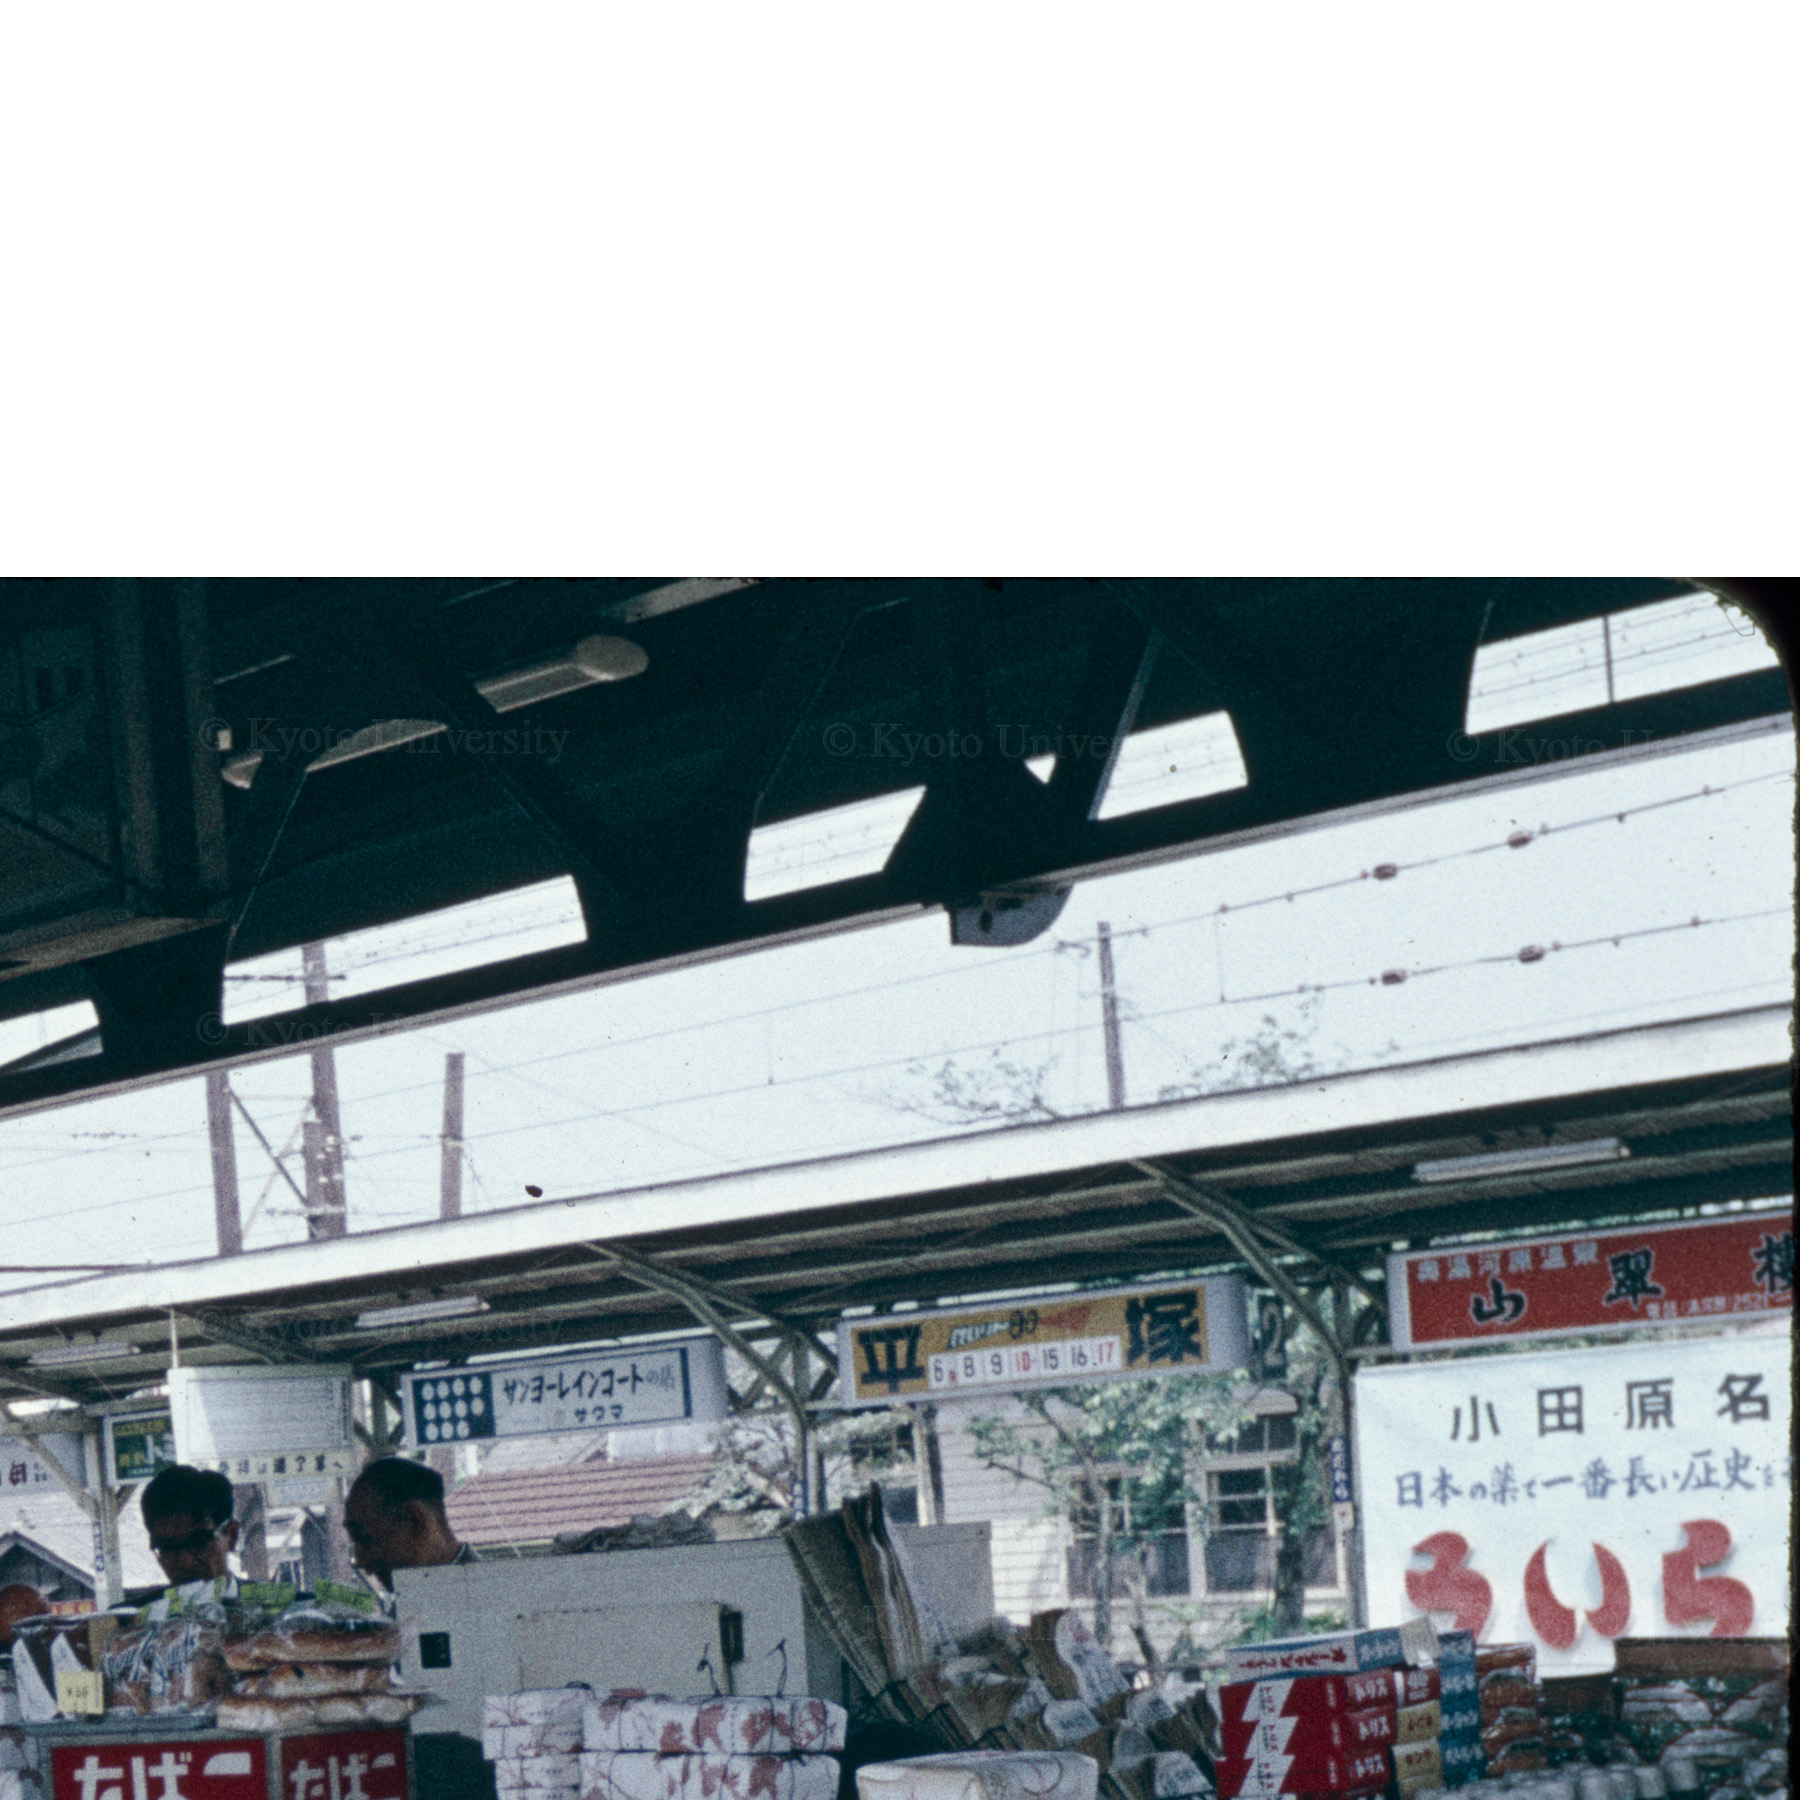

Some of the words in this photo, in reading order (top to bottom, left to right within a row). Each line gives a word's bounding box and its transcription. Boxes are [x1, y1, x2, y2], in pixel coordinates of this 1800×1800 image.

[1354, 1676, 1389, 1702] トリス
[1358, 1715, 1390, 1741] トリス
